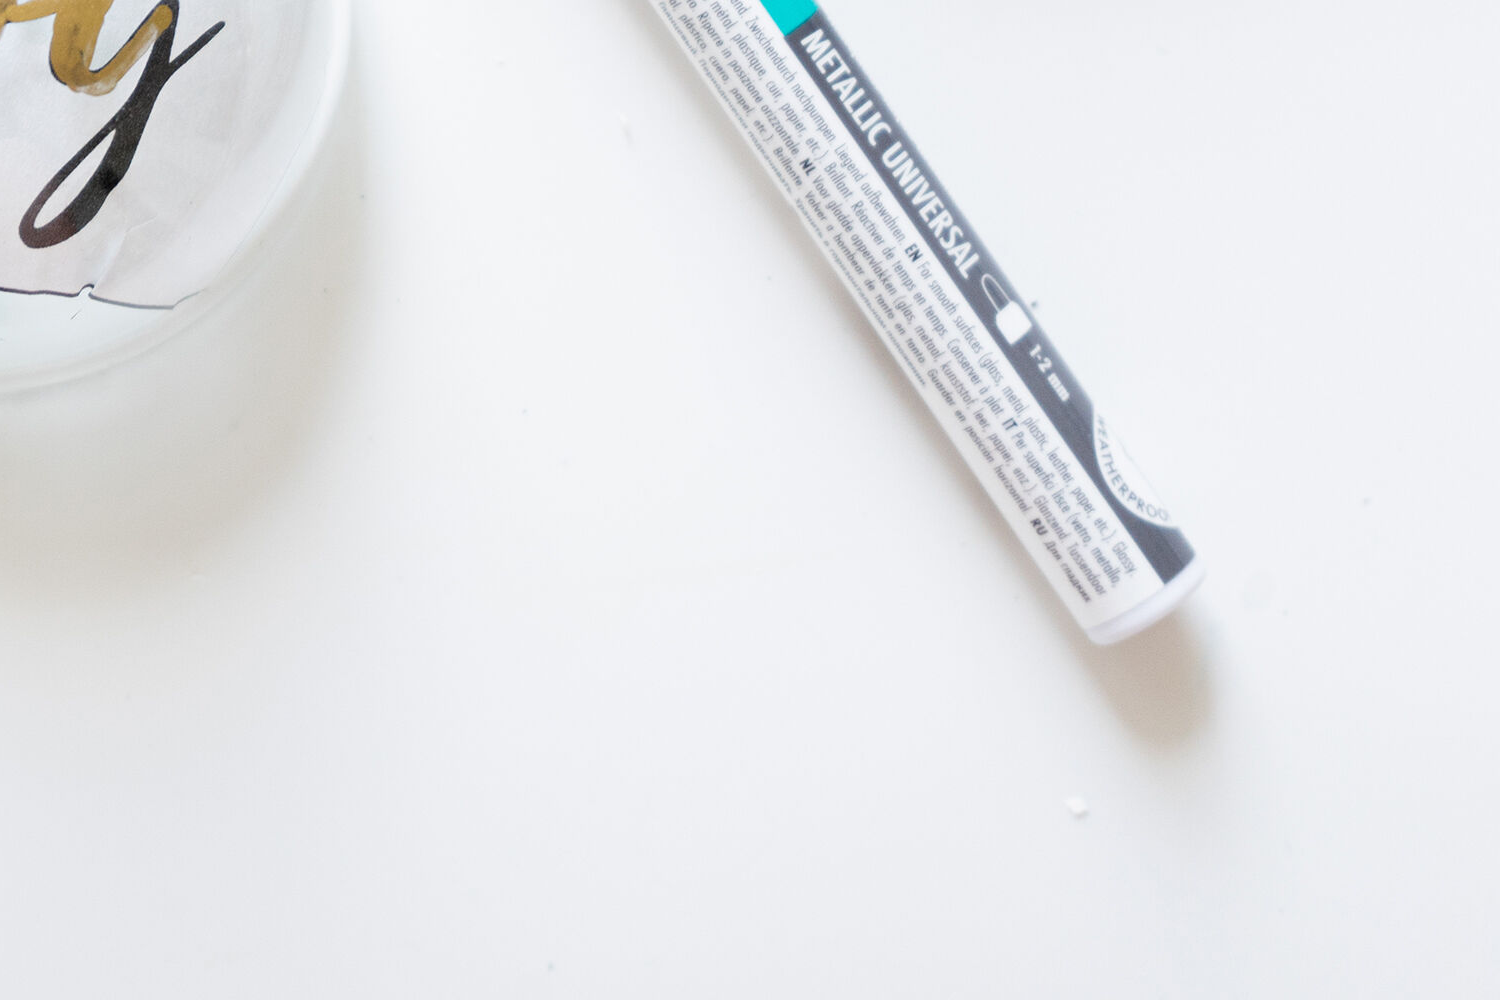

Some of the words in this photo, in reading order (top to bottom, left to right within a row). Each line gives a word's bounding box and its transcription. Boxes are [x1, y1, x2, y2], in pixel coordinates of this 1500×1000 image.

[744, 15, 798, 84] Zwischendurch
[834, 142, 868, 183] Liegend
[904, 242, 924, 263] EN
[917, 261, 932, 280] For
[928, 280, 959, 316] smooth
[952, 315, 984, 354] surfaces
[800, 28, 892, 147] METALLIC
[881, 141, 981, 280] UNIVERSAL
[850, 200, 885, 246] Réactiver
[881, 246, 896, 261] de
[891, 259, 917, 292] temps
[913, 291, 927, 306] en
[946, 338, 982, 385] Conserver
[978, 385, 991, 395] à
[1001, 417, 1019, 432] IT
[1011, 431, 1027, 450] Per
[1023, 451, 1055, 490] superfici
[1051, 488, 1071, 513] lisce
[1029, 344, 1052, 373] 1-2
[1047, 372, 1071, 402] mm
